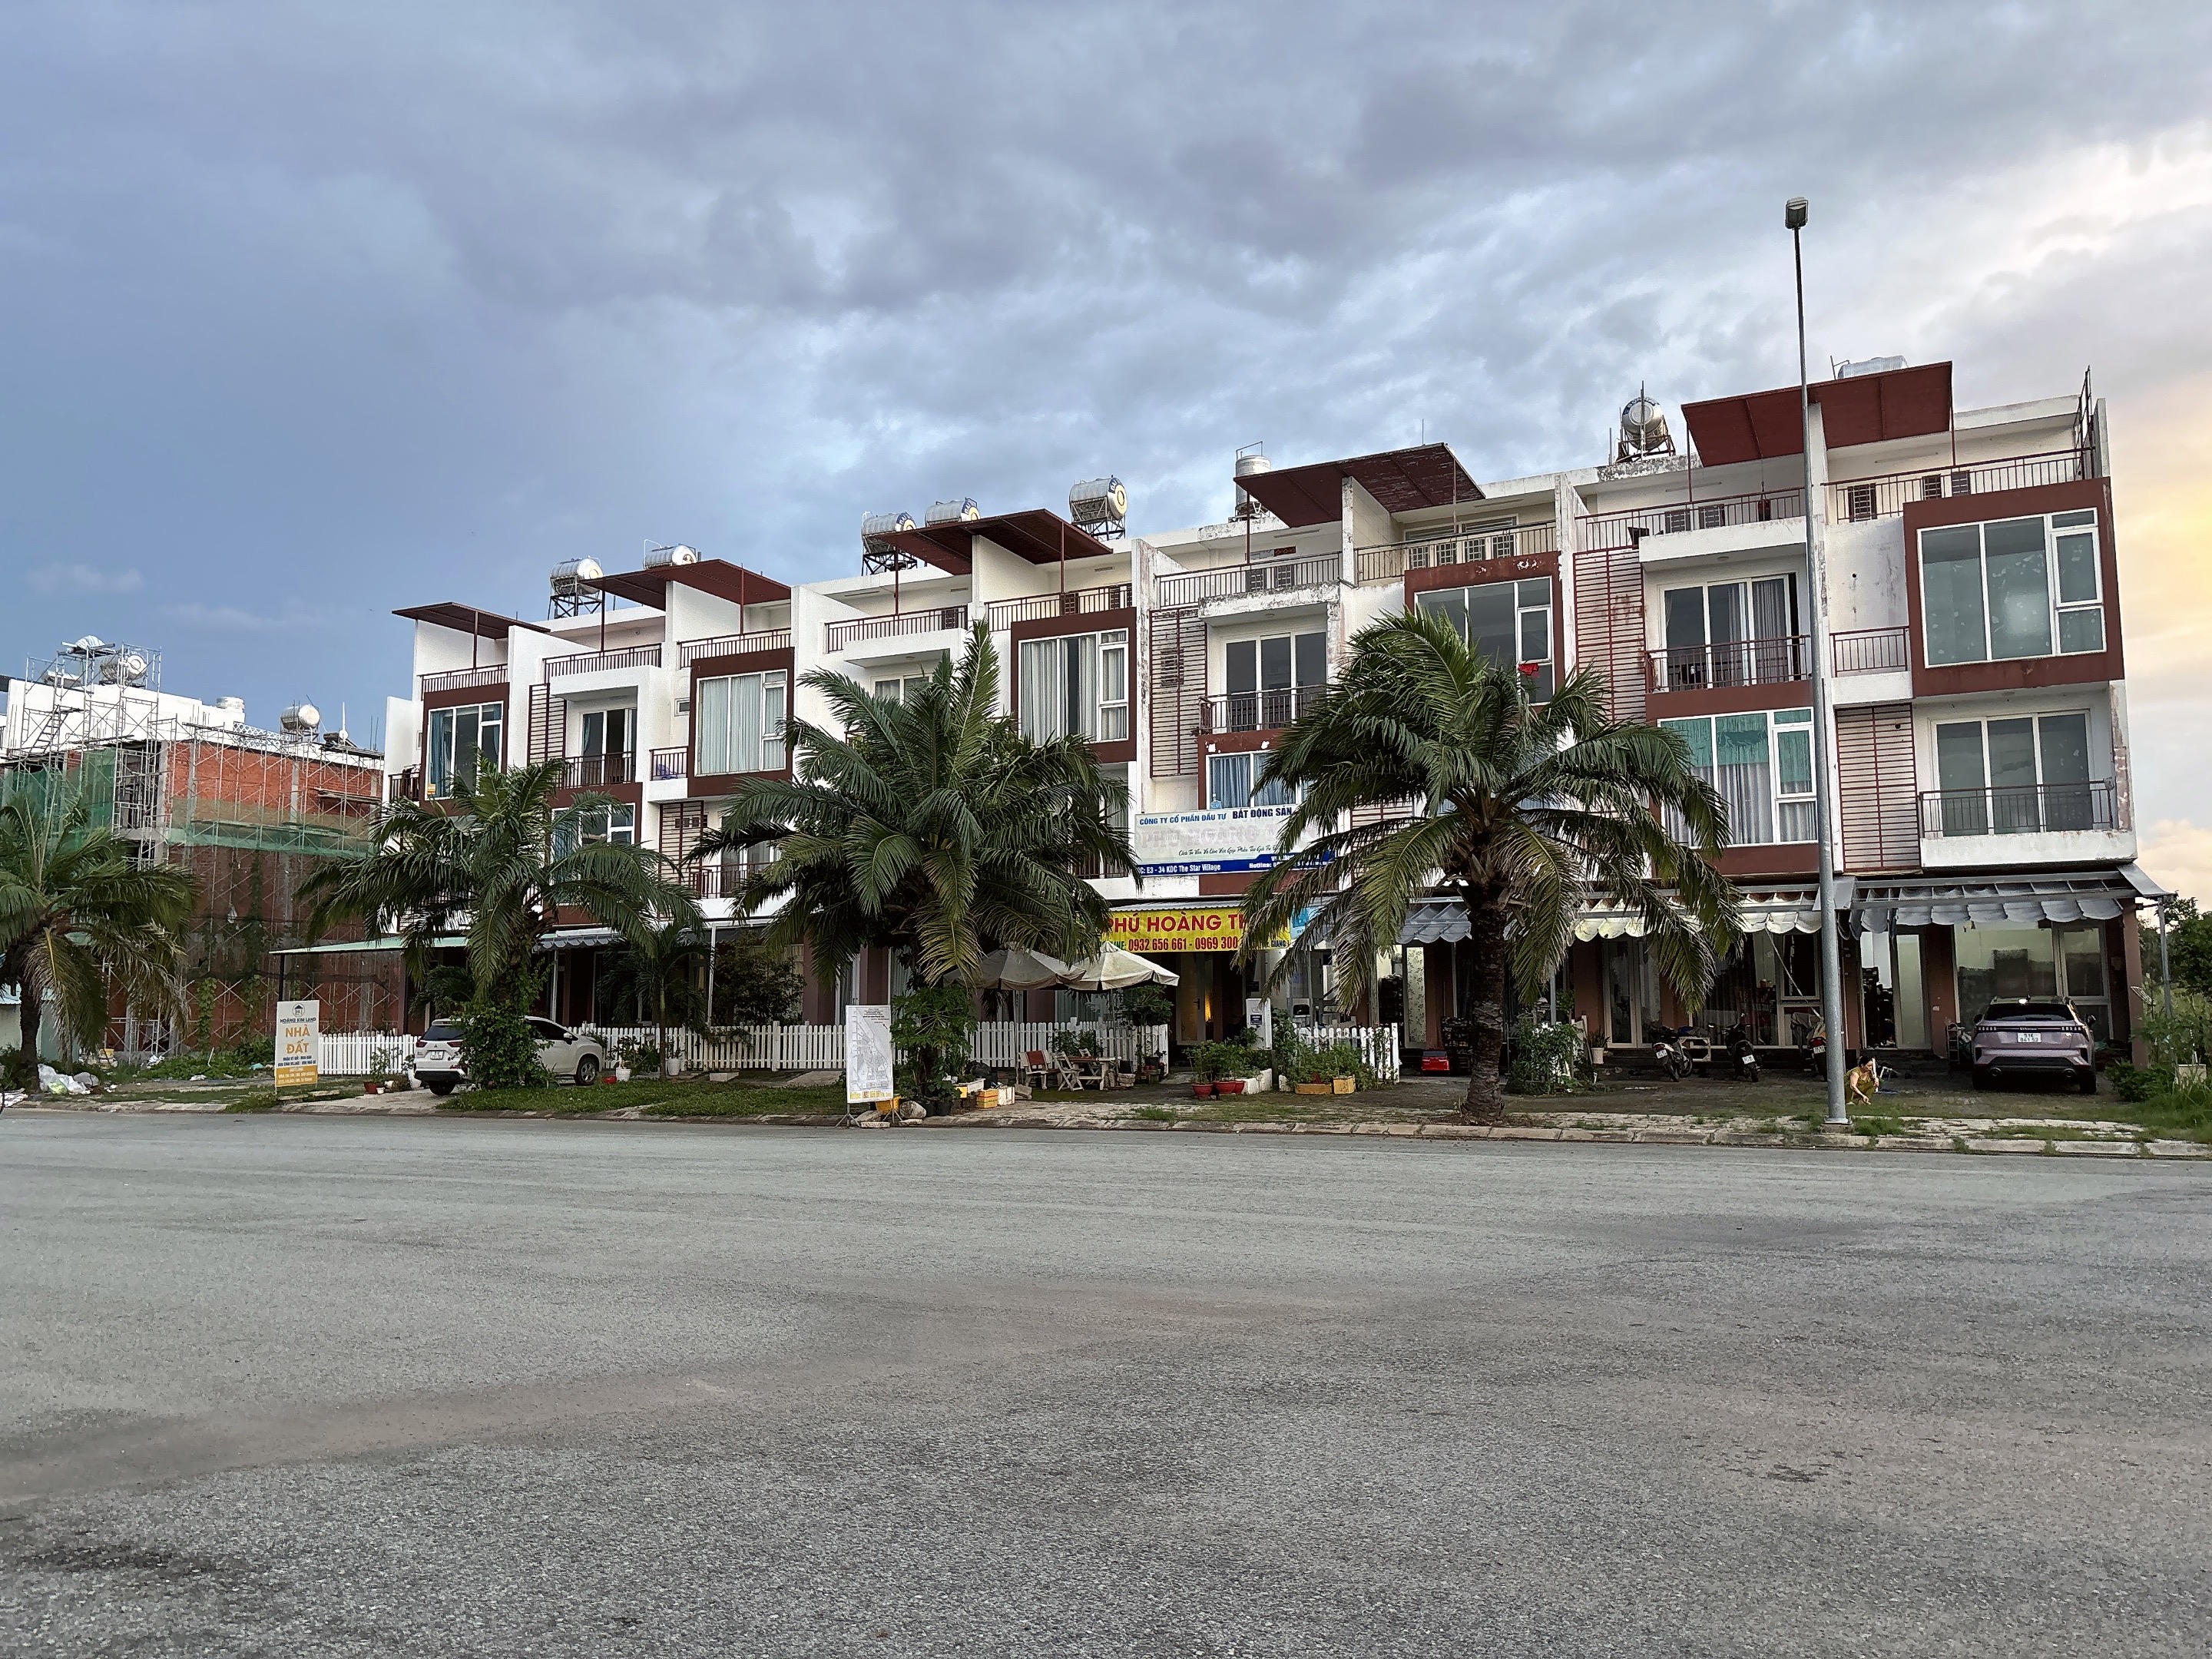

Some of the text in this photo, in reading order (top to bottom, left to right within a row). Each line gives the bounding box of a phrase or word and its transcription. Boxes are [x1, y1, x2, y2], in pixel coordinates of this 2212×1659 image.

[1232, 808, 1249, 819] BẤT
[1250, 808, 1273, 819] ĐỘNG
[1275, 805, 1293, 816] SẢN
[1147, 910, 1222, 932] HOÀNG
[1128, 938, 1150, 951] 0932
[1152, 938, 1169, 951] 656
[1171, 937, 1187, 950] 661
[1195, 936, 1218, 950] 0969
[1221, 936, 1238, 949] 300
[285, 1024, 310, 1038] NHÀ
[286, 1038, 309, 1054] ĐẤT
